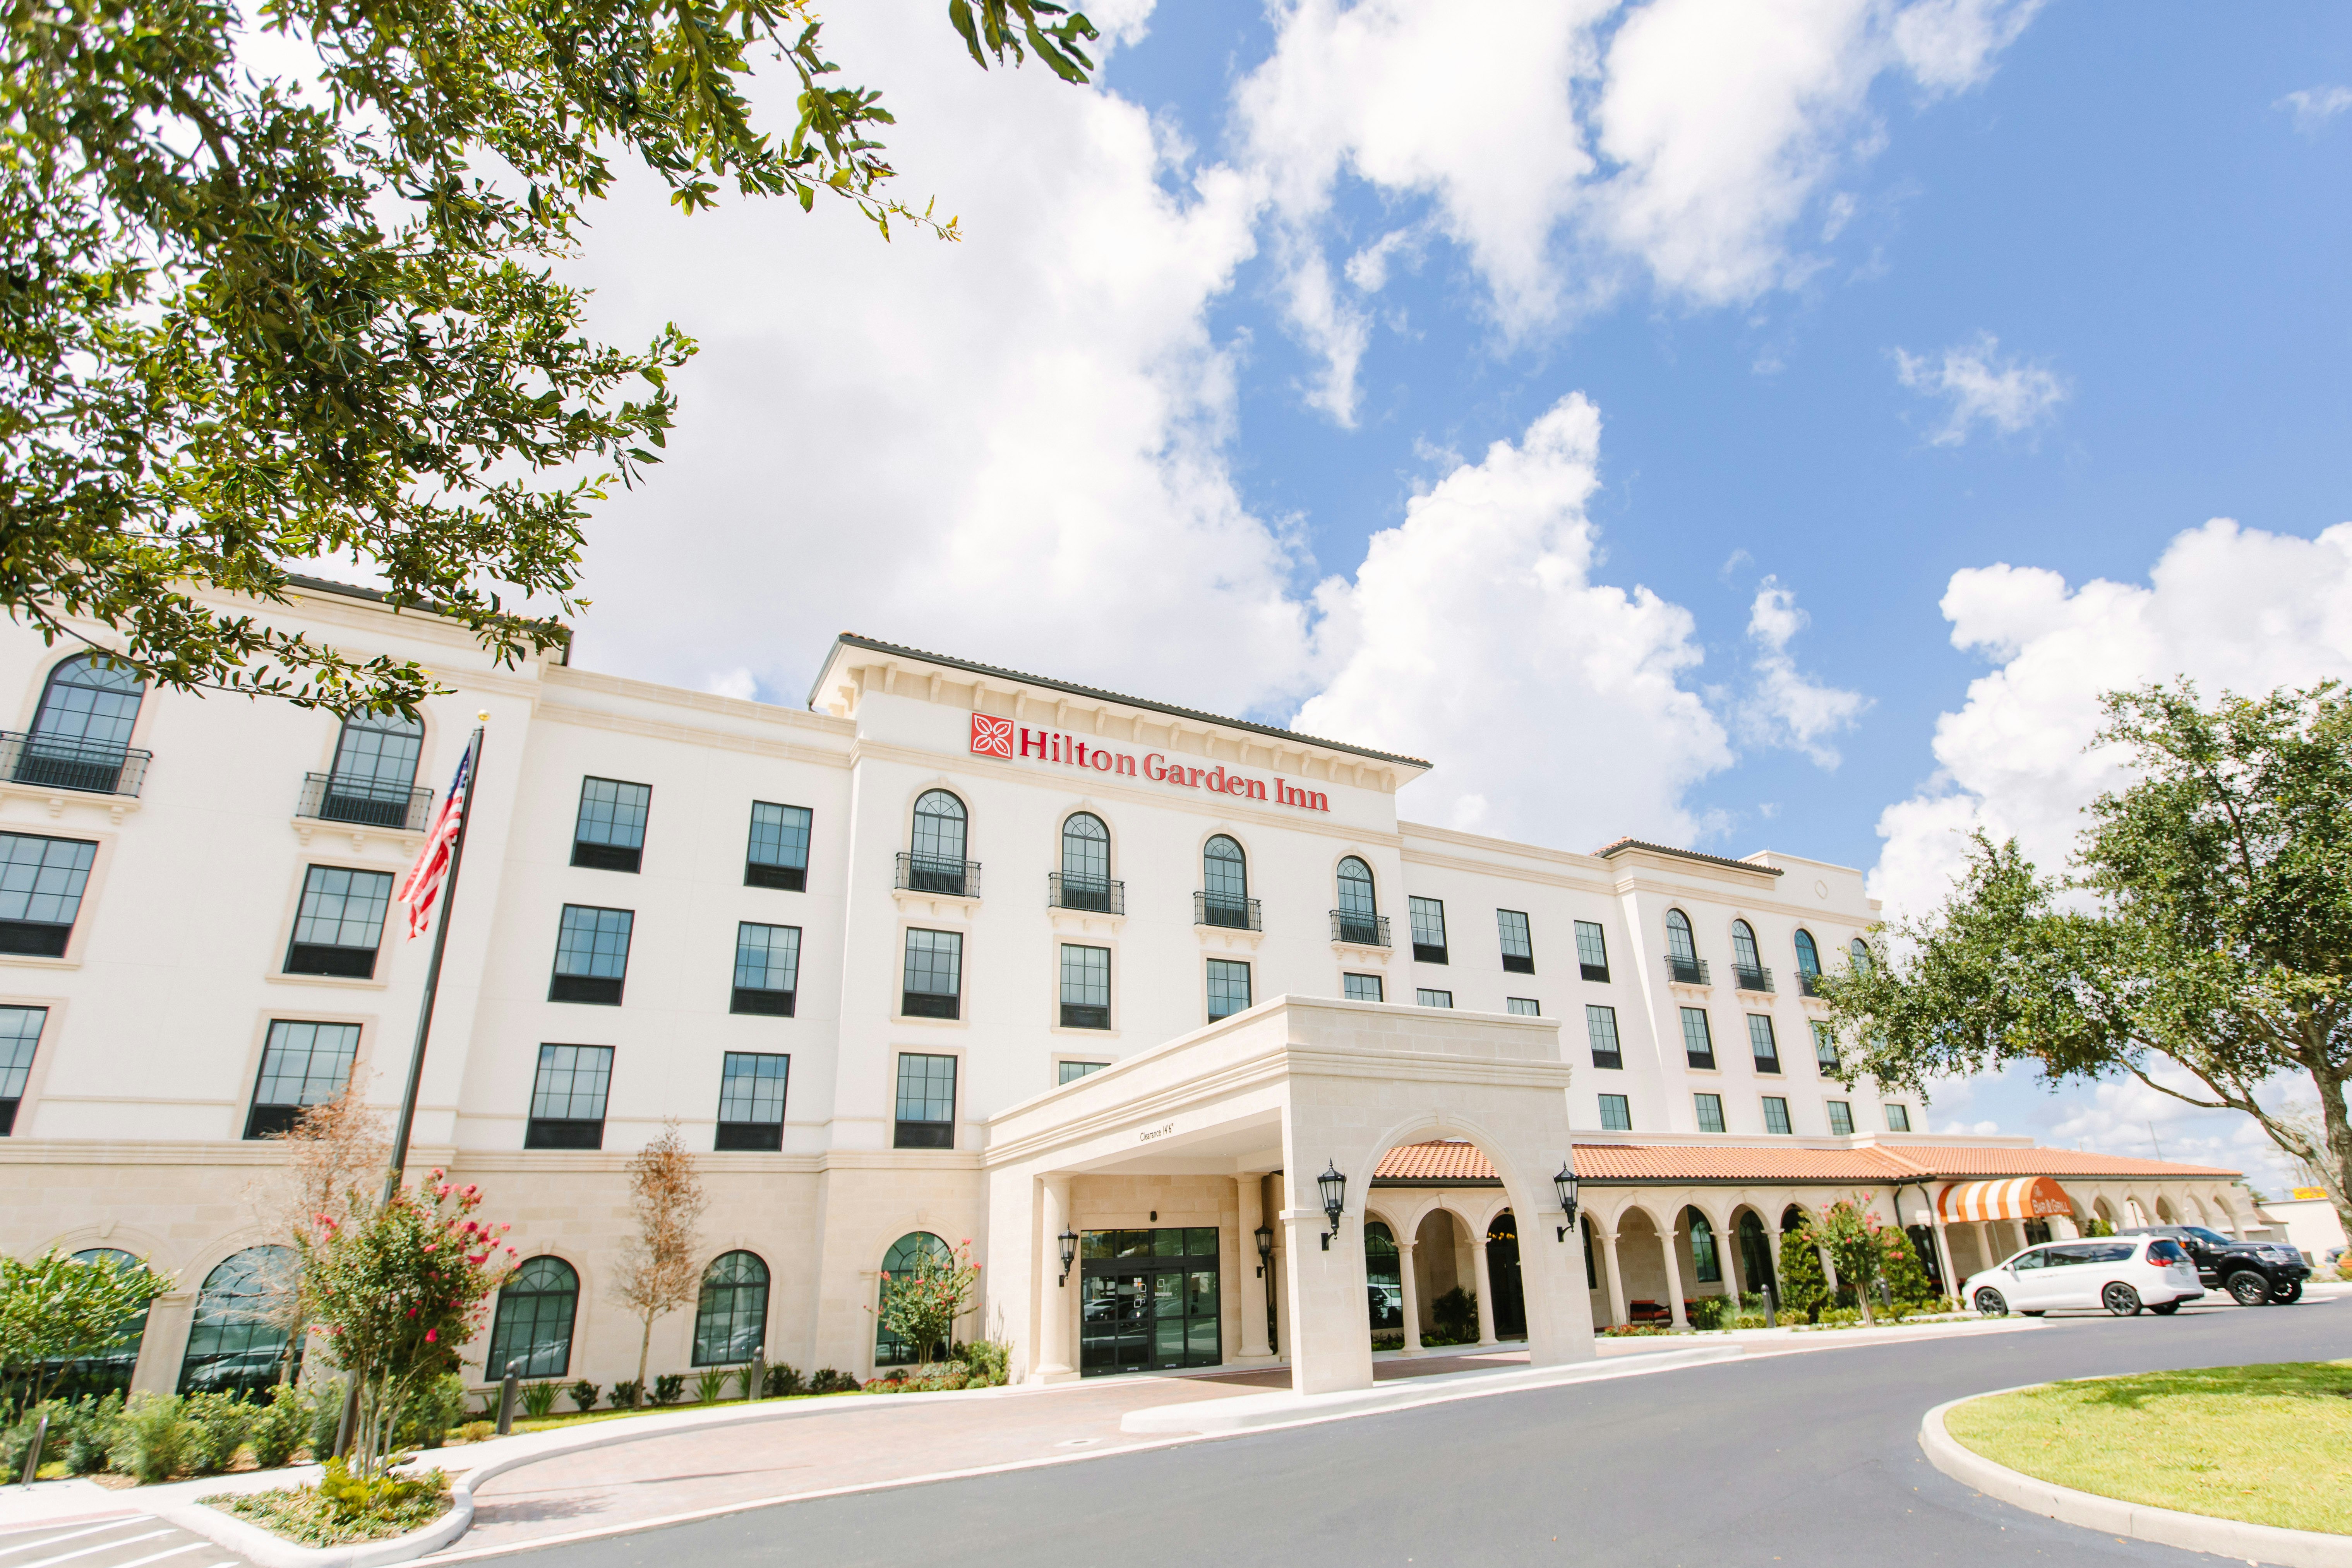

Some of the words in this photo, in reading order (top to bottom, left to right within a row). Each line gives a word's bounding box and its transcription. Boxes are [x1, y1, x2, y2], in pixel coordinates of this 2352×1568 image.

[1019, 728, 1137, 776] Hilton
[1143, 753, 1268, 801] Garden
[1274, 777, 1330, 812] Inn
[1140, 1130, 1161, 1141] Clearance
